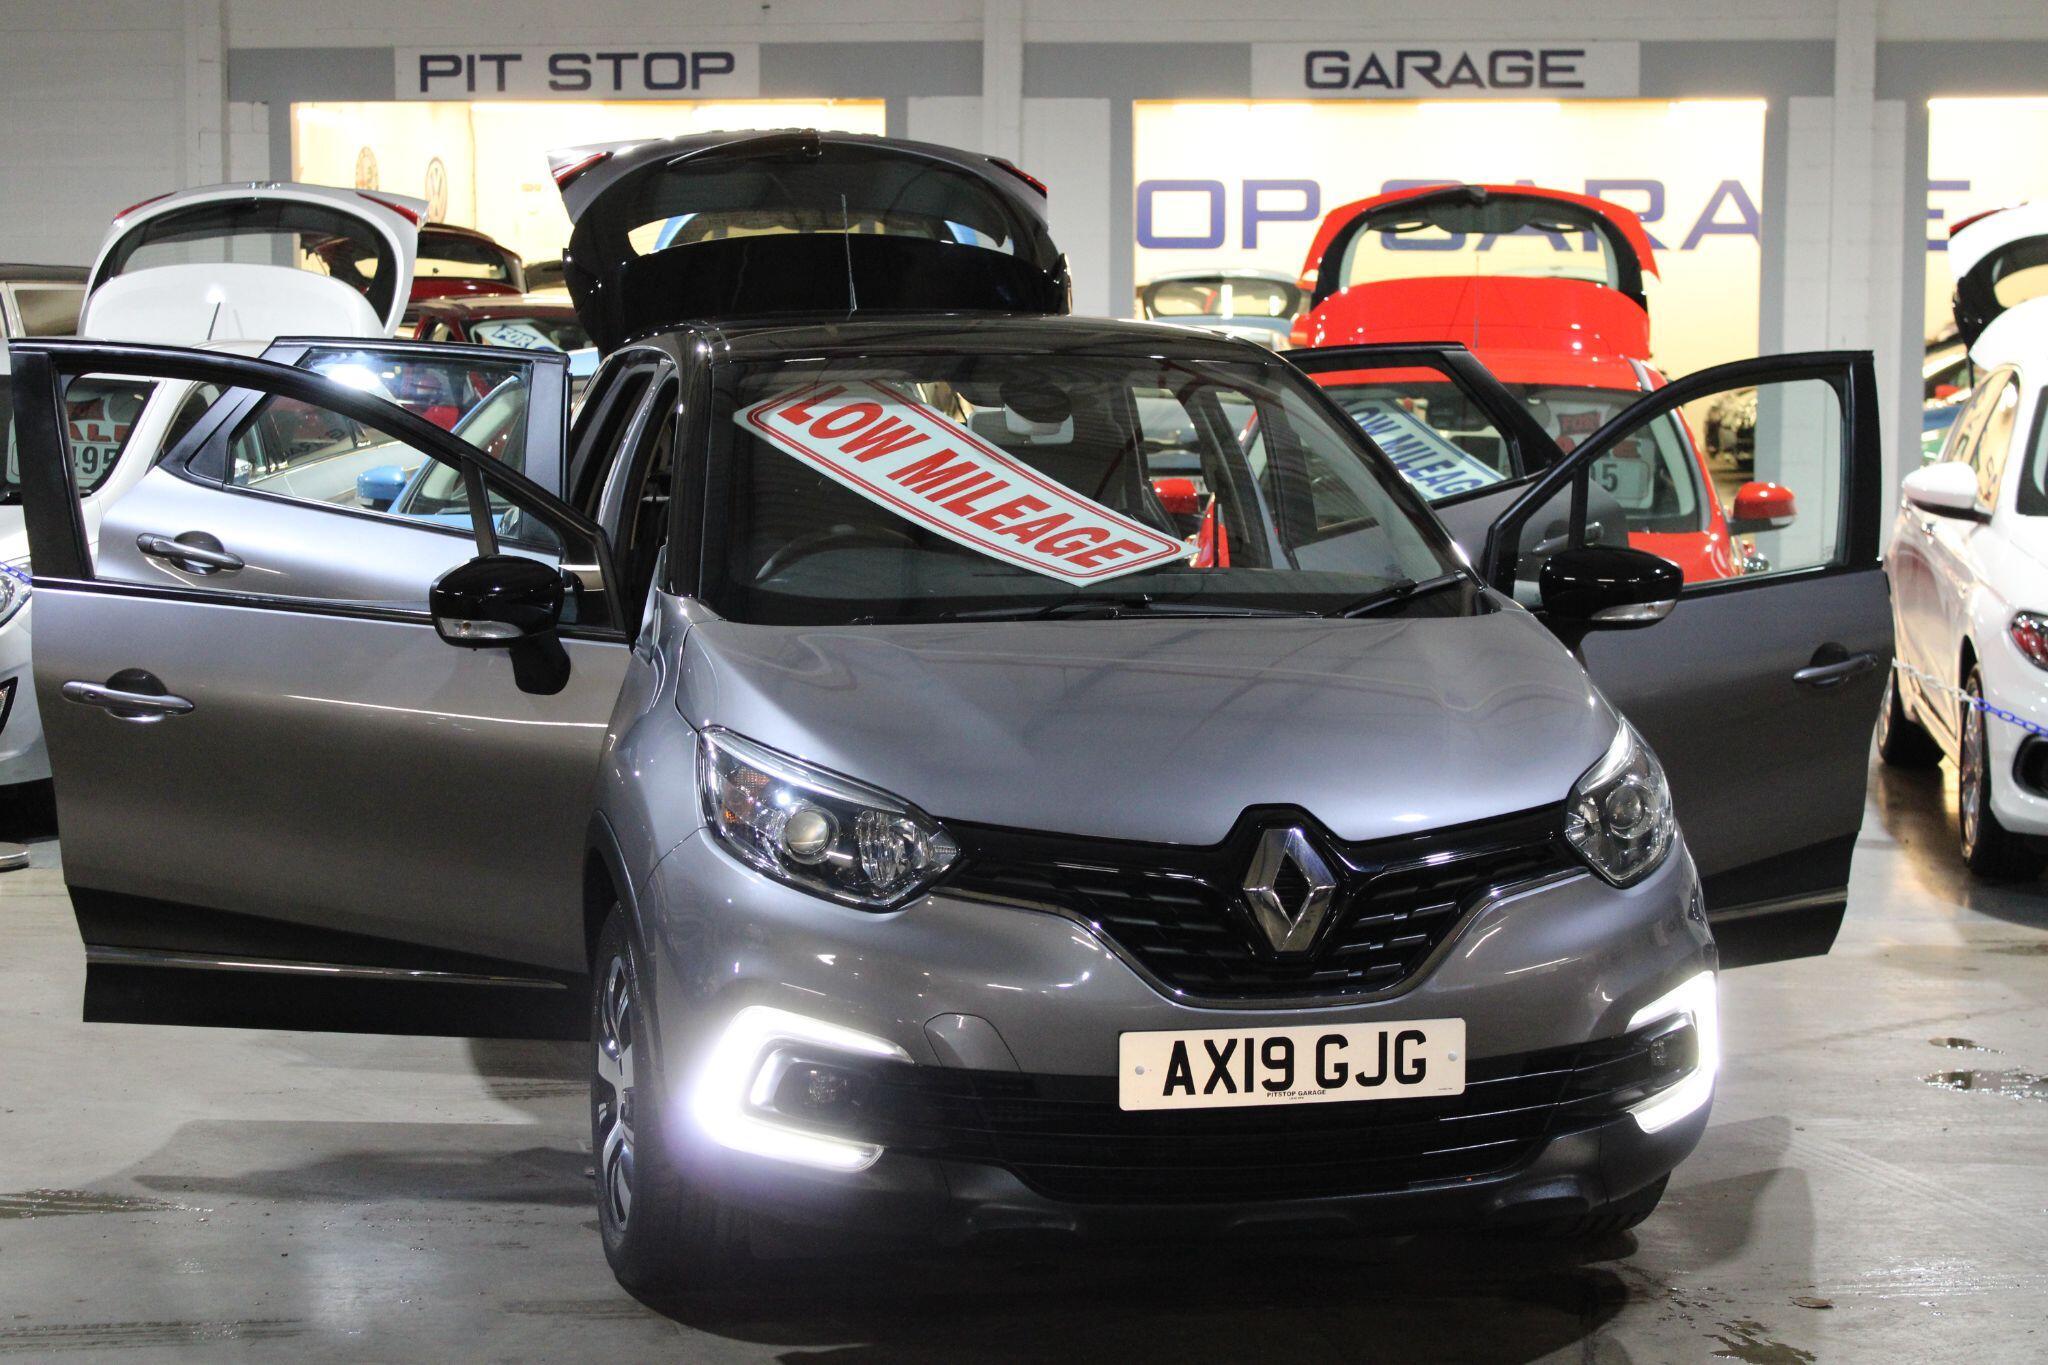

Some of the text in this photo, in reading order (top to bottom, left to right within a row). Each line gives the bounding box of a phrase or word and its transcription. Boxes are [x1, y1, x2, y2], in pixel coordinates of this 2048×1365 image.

[420, 51, 735, 92] PIT STOP
[1305, 50, 1585, 89] GARAGE
[777, 384, 1150, 568] LOW MILEAGE
[1344, 401, 1484, 496] OW MILEAG
[1163, 1030, 1427, 1096] AX19 GJG
